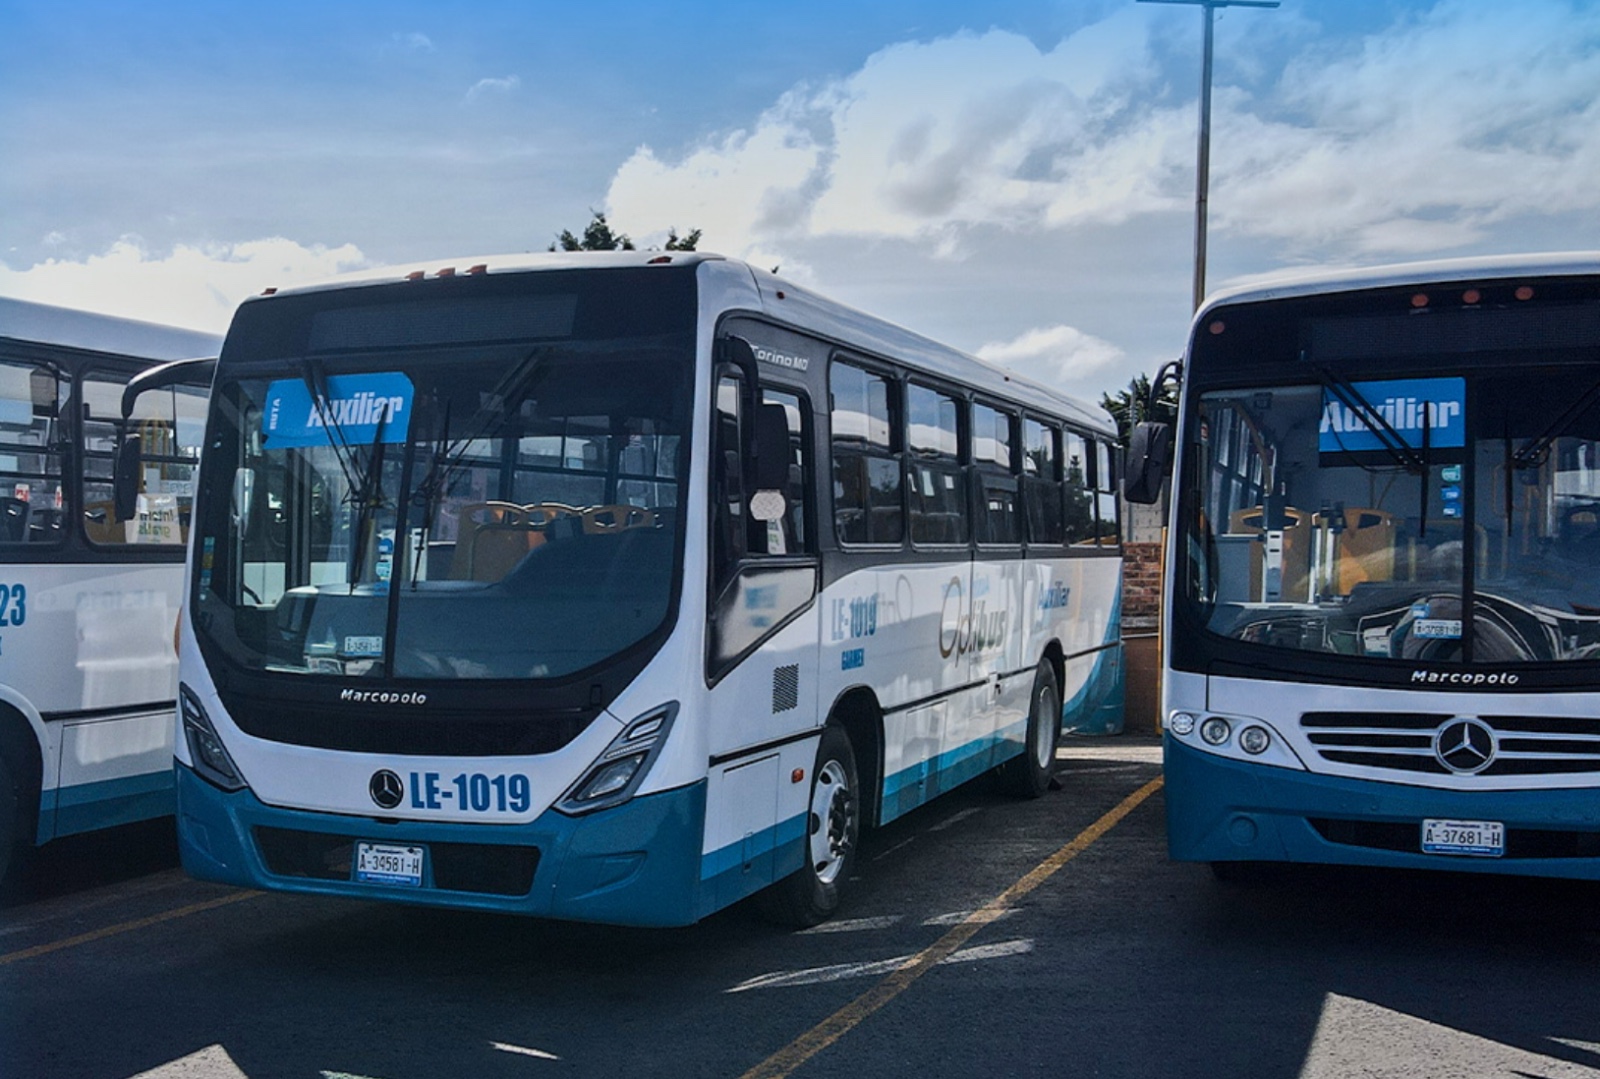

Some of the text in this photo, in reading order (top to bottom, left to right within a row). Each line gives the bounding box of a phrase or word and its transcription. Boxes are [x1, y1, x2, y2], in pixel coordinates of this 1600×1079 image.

[306, 391, 404, 428] Auxiliar
[1319, 397, 1460, 433] Auxiliar
[831, 593, 878, 641] LE-1019
[1411, 670, 1519, 685] Marcopolo
[340, 688, 427, 704] Marcopolo
[410, 772, 531, 813] LE-1019
[1426, 828, 1500, 846] A-37681-H
[360, 854, 419, 874] A-34581-H
